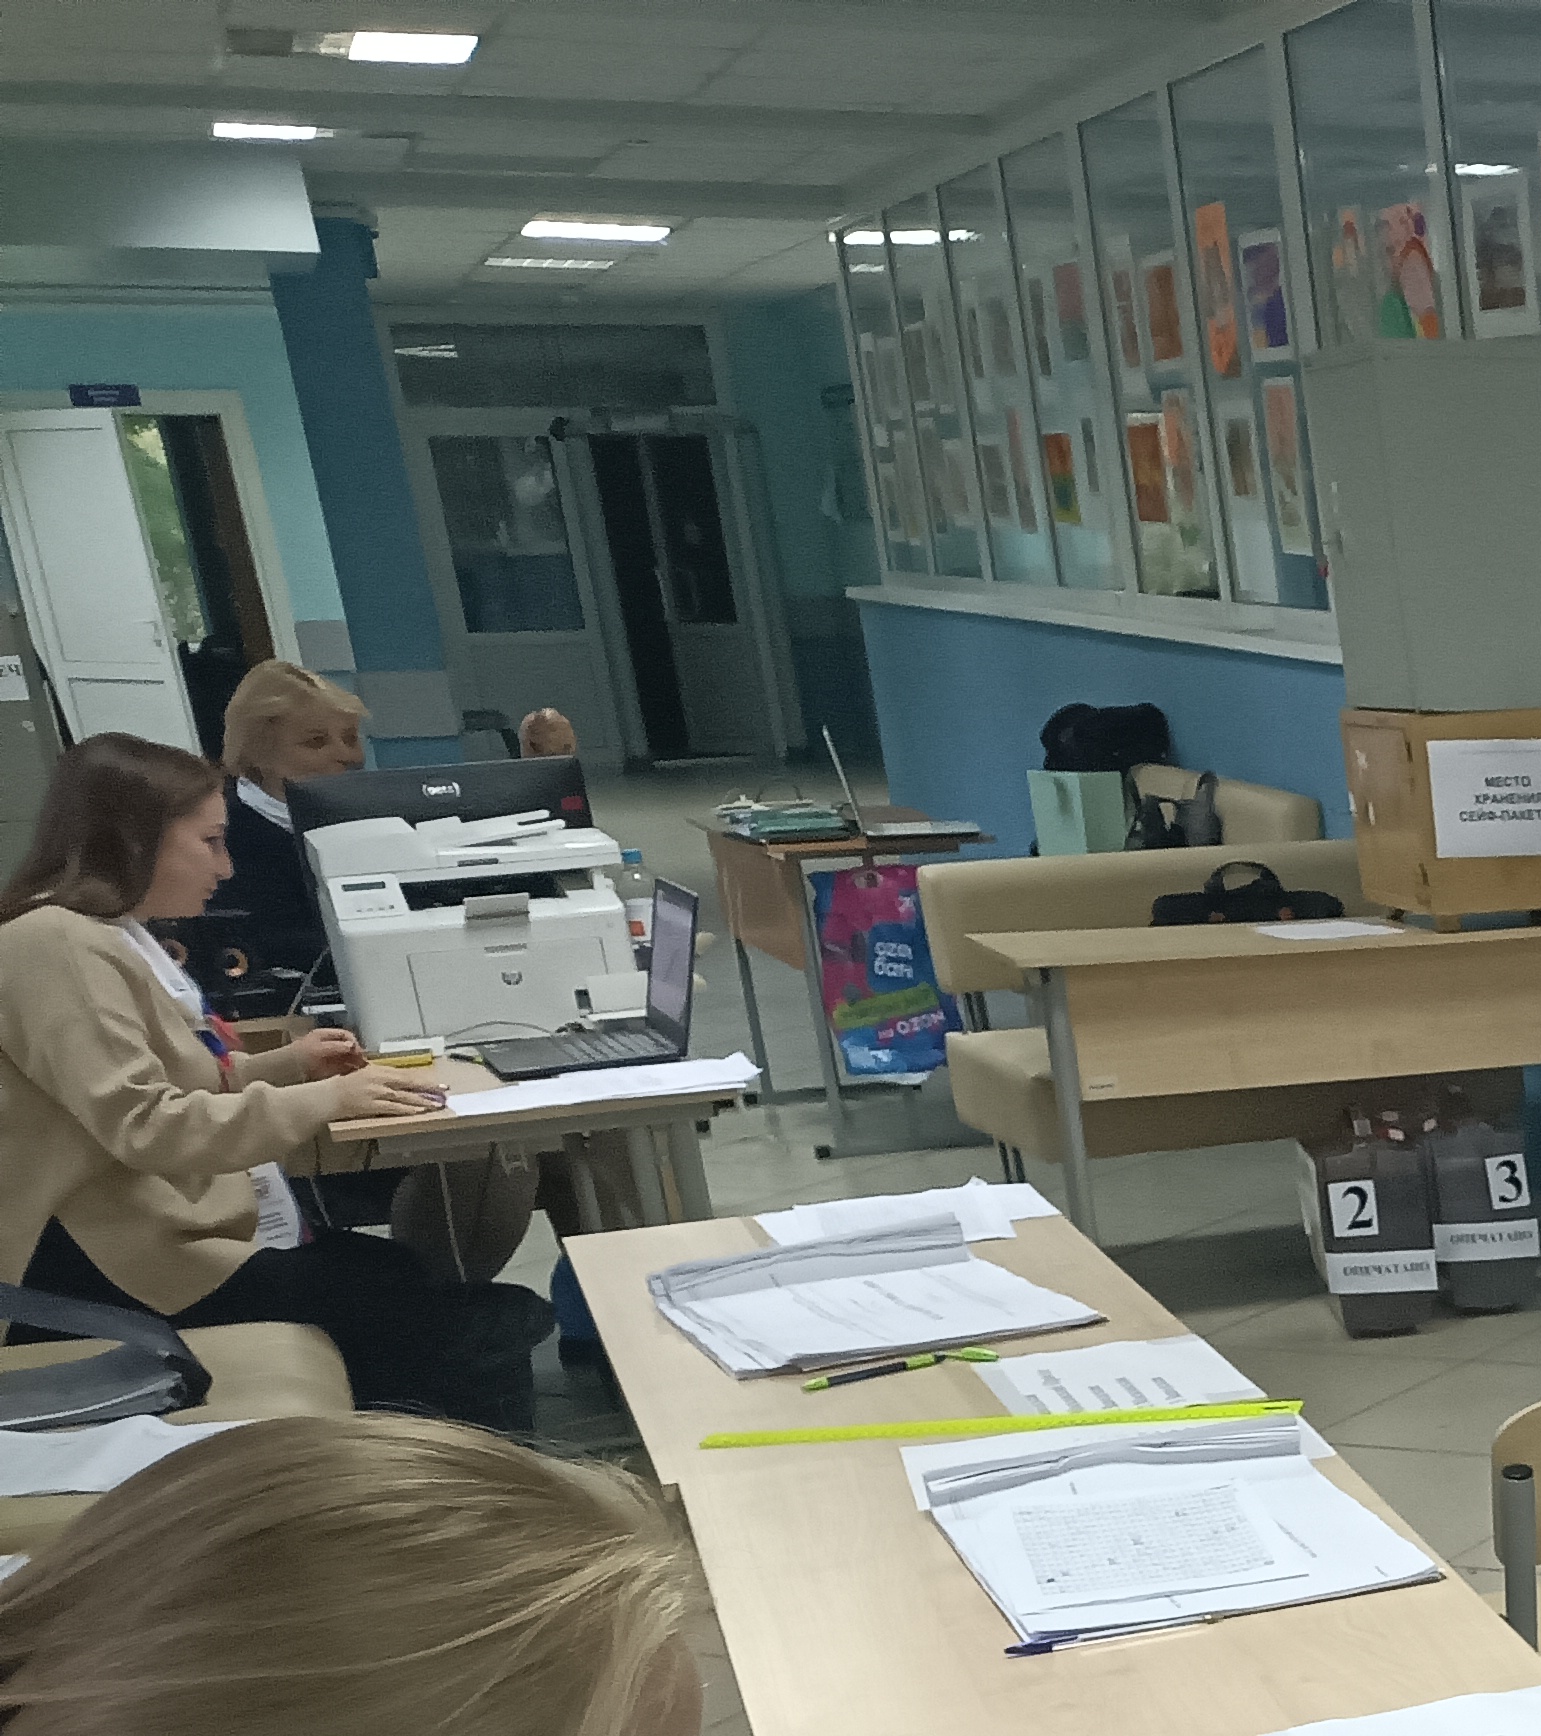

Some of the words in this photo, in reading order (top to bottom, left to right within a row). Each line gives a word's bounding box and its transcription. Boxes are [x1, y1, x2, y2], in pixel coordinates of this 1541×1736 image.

[1484, 775, 1532, 788] МЕСТО
[1495, 1159, 1523, 1203] 3
[1341, 1185, 1374, 1231] 2
